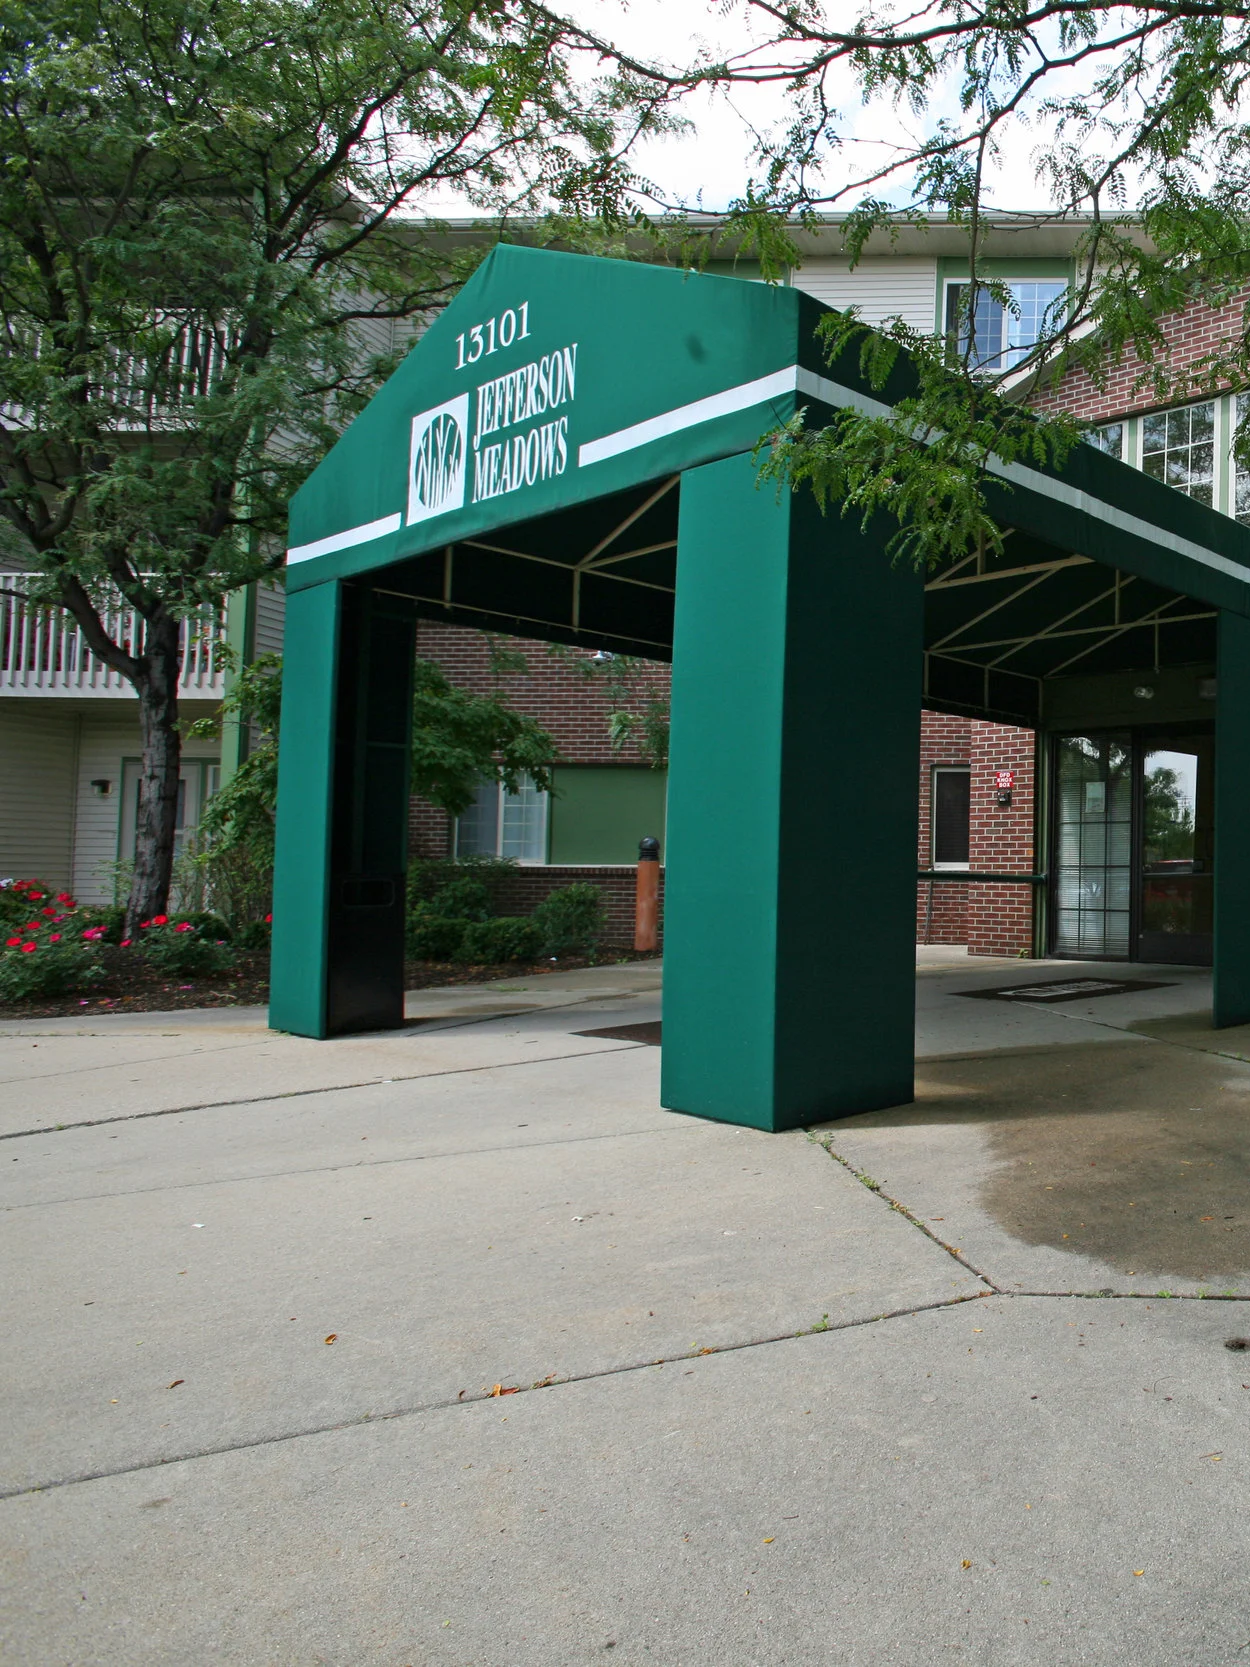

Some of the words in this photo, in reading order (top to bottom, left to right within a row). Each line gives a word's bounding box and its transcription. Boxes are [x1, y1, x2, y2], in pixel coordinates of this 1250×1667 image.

[455, 301, 531, 370] 13101
[473, 343, 578, 450] JEFFERSON
[472, 416, 568, 503] MEADOWS
